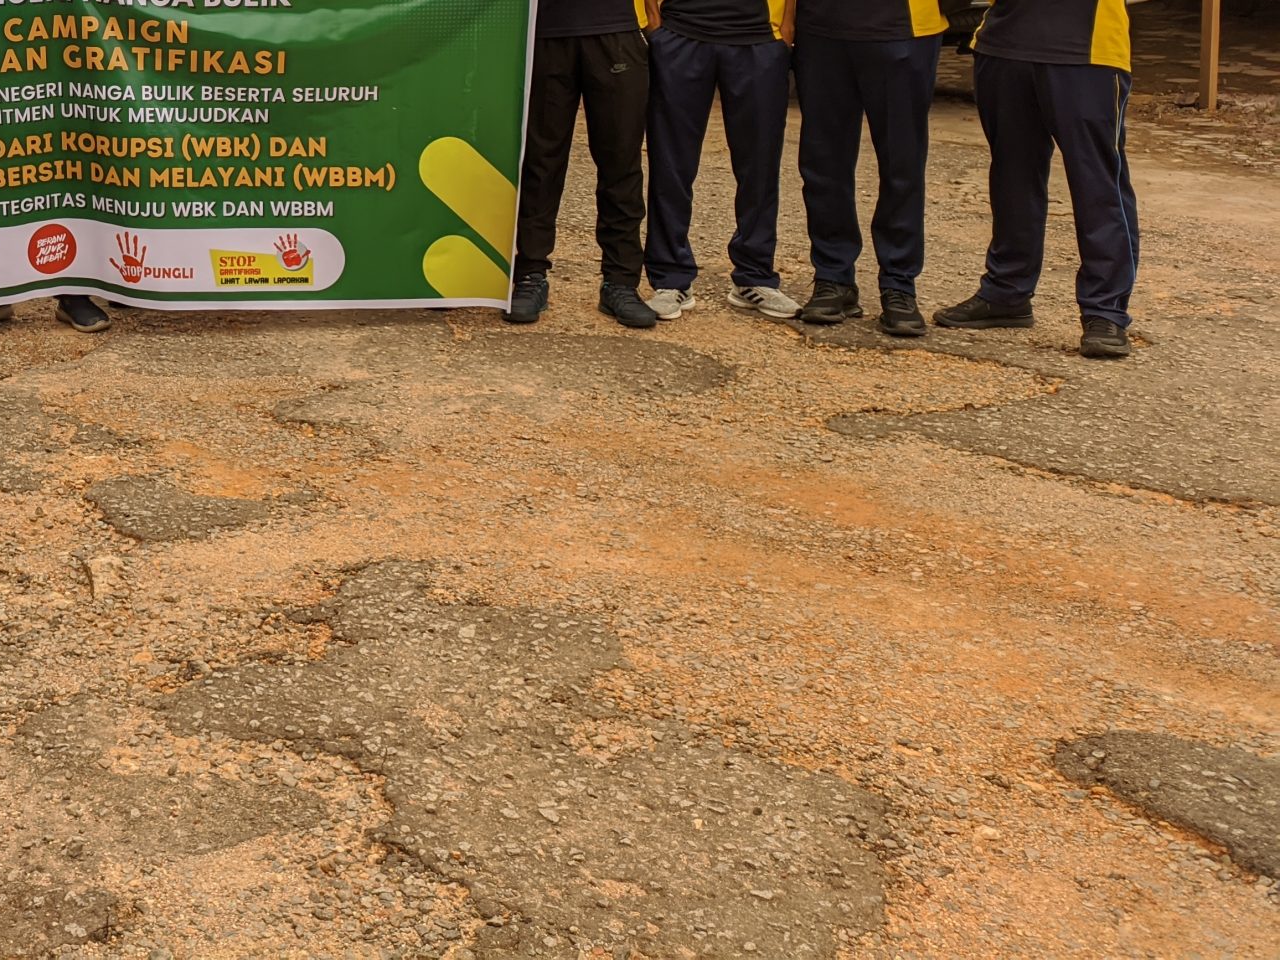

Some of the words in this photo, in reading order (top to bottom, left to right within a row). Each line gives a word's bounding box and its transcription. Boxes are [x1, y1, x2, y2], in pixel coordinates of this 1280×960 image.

[3, 14, 188, 43] CAMPAIGN
[63, 46, 286, 74] GRATIFIKASI
[69, 82, 136, 100] NANGA
[141, 85, 195, 101] BULIK
[201, 86, 286, 103] BESERTA
[292, 86, 379, 102] SELURUH
[60, 104, 121, 123] UNTUK
[127, 107, 270, 124] MEWUJUDKAN
[60, 131, 175, 158] KORUPSI
[181, 133, 262, 161] (WBK)
[269, 137, 328, 158] DAN
[90, 163, 141, 188] DAN
[149, 167, 286, 188] MELAYANI
[292, 162, 397, 192] (WBBM)
[91, 194, 166, 218] MENUJU
[171, 201, 217, 218] WBK
[222, 201, 265, 217] DAN
[269, 200, 335, 218] WBBM
[219, 255, 256, 267] STOP
[122, 265, 142, 277] STOP
[144, 267, 194, 279] PUNGLI
[219, 268, 261, 276] GRATIFIKASI
[220, 277, 240, 285] LIHAT
[273, 276, 309, 284] LAPORKAN
